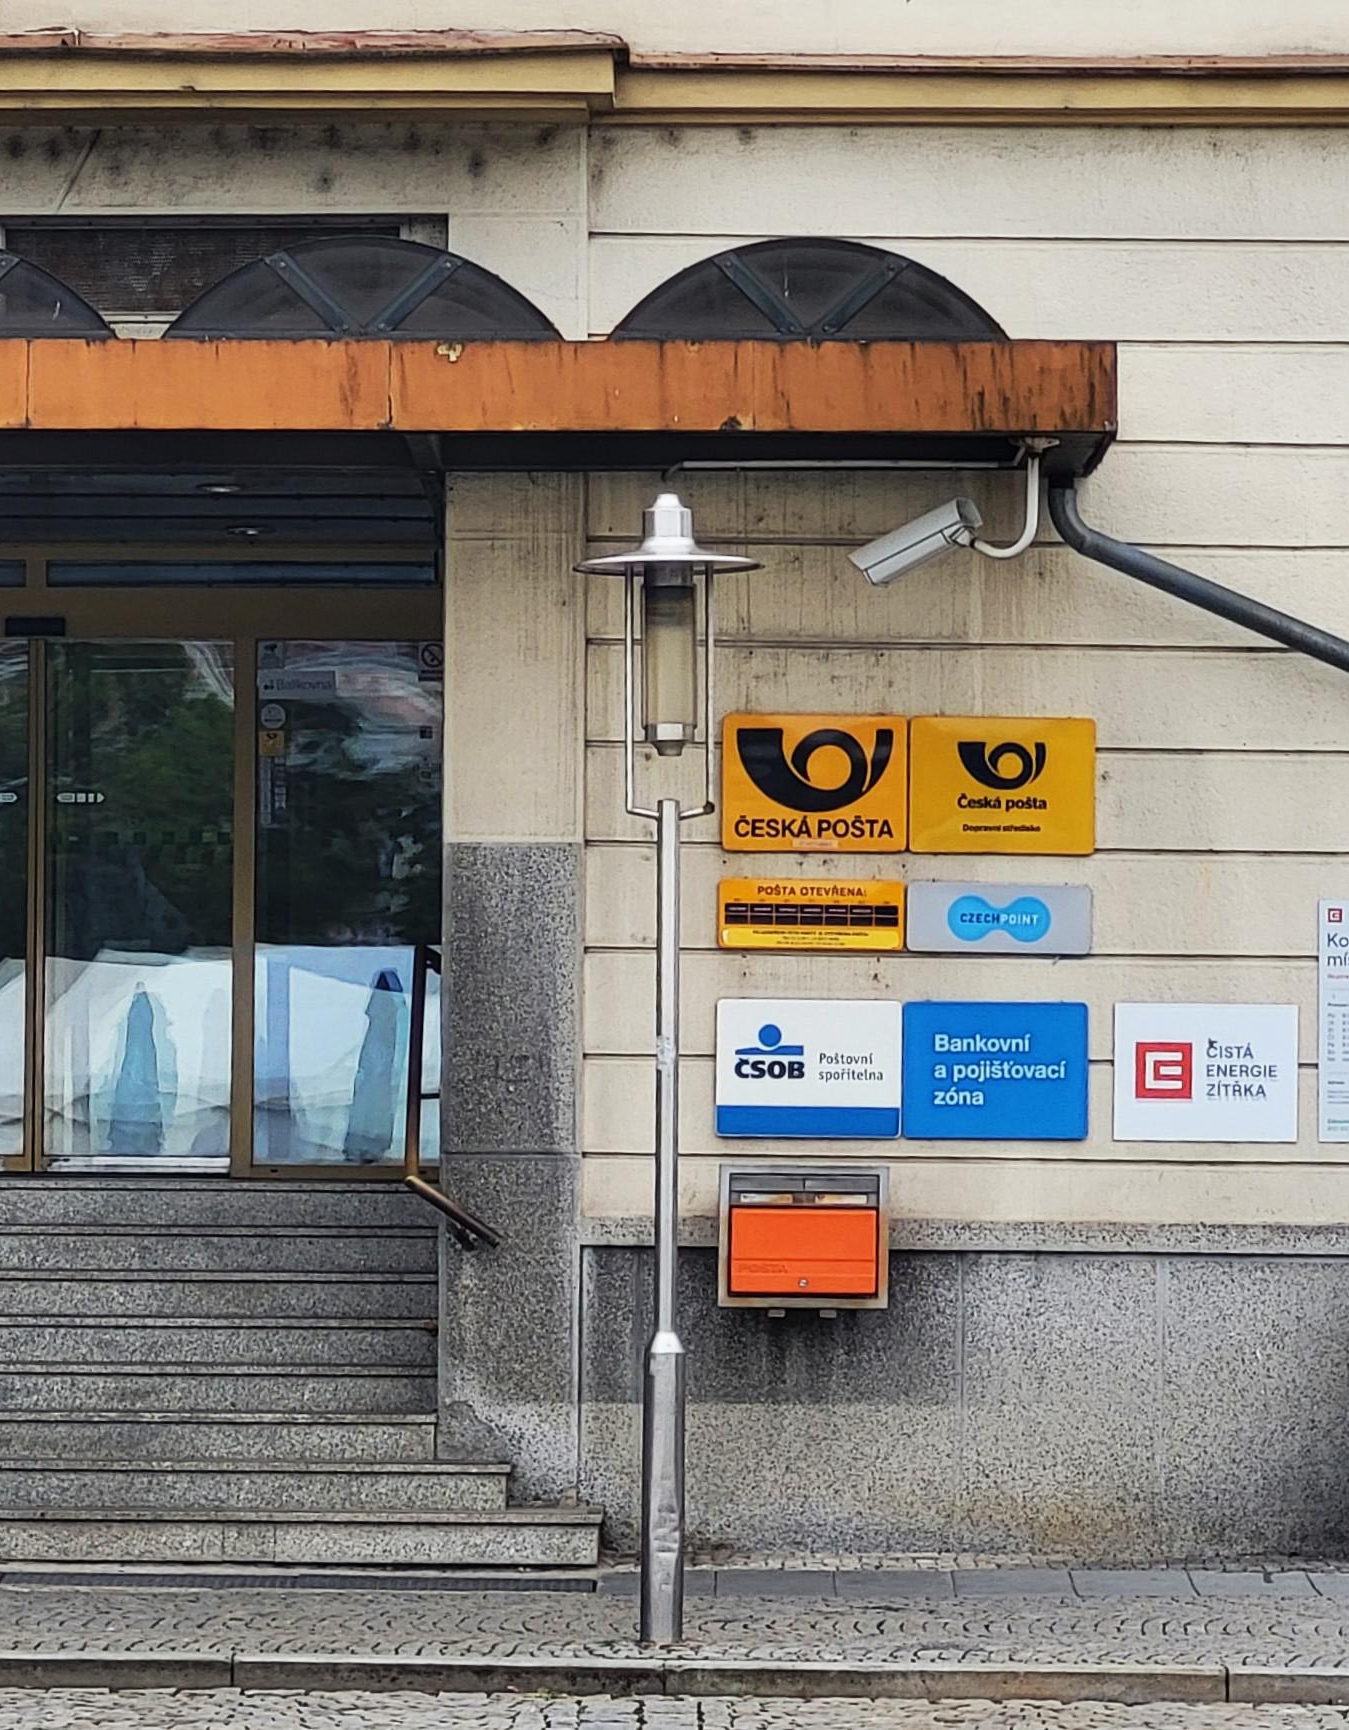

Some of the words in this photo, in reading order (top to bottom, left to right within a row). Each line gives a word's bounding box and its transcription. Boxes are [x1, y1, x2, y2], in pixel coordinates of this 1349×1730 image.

[957, 793, 1001, 809] Česká
[1005, 797, 1047, 812] pošta
[734, 815, 812, 838] ČESKÁ
[817, 815, 894, 839] POŠTA
[757, 884, 796, 896] POŠTA
[1327, 951, 1349, 967] mí
[934, 1033, 1031, 1053] Bankovní
[1206, 1039, 1254, 1059] ČISTÁ
[819, 1052, 873, 1065] Poštovní
[734, 1058, 805, 1079] ČSOB
[819, 1068, 884, 1083] spořitelna
[934, 1064, 947, 1079] a
[953, 1060, 1067, 1082] pojišťovací
[1206, 1064, 1277, 1078] ENERGIE
[934, 1086, 984, 1106] zóna
[1206, 1080, 1267, 1097] ZÍTŘKA
